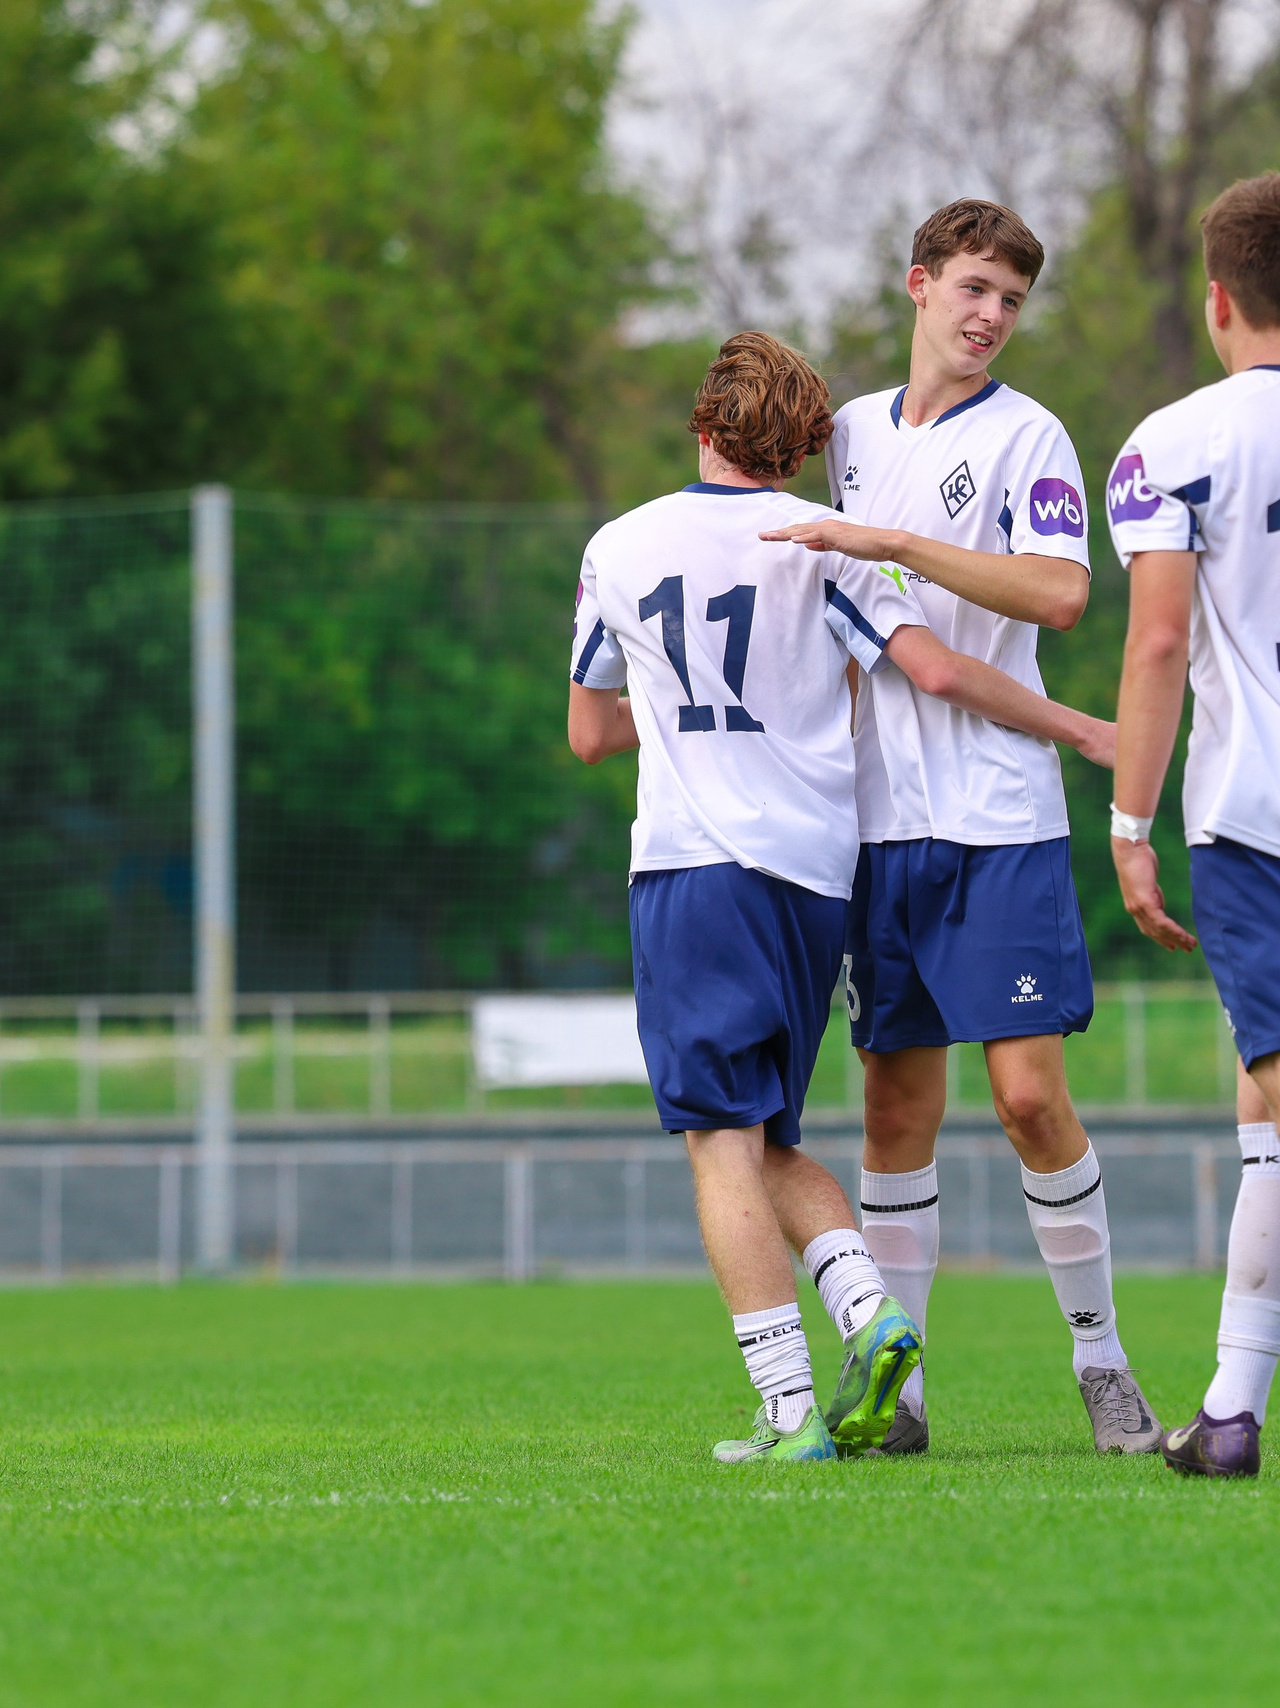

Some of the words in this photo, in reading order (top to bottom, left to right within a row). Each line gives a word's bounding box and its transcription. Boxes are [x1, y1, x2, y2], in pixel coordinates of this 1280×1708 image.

[1034, 492, 1081, 525] wb
[639, 575, 766, 734] 11
[1011, 994, 1043, 1003] KELME
